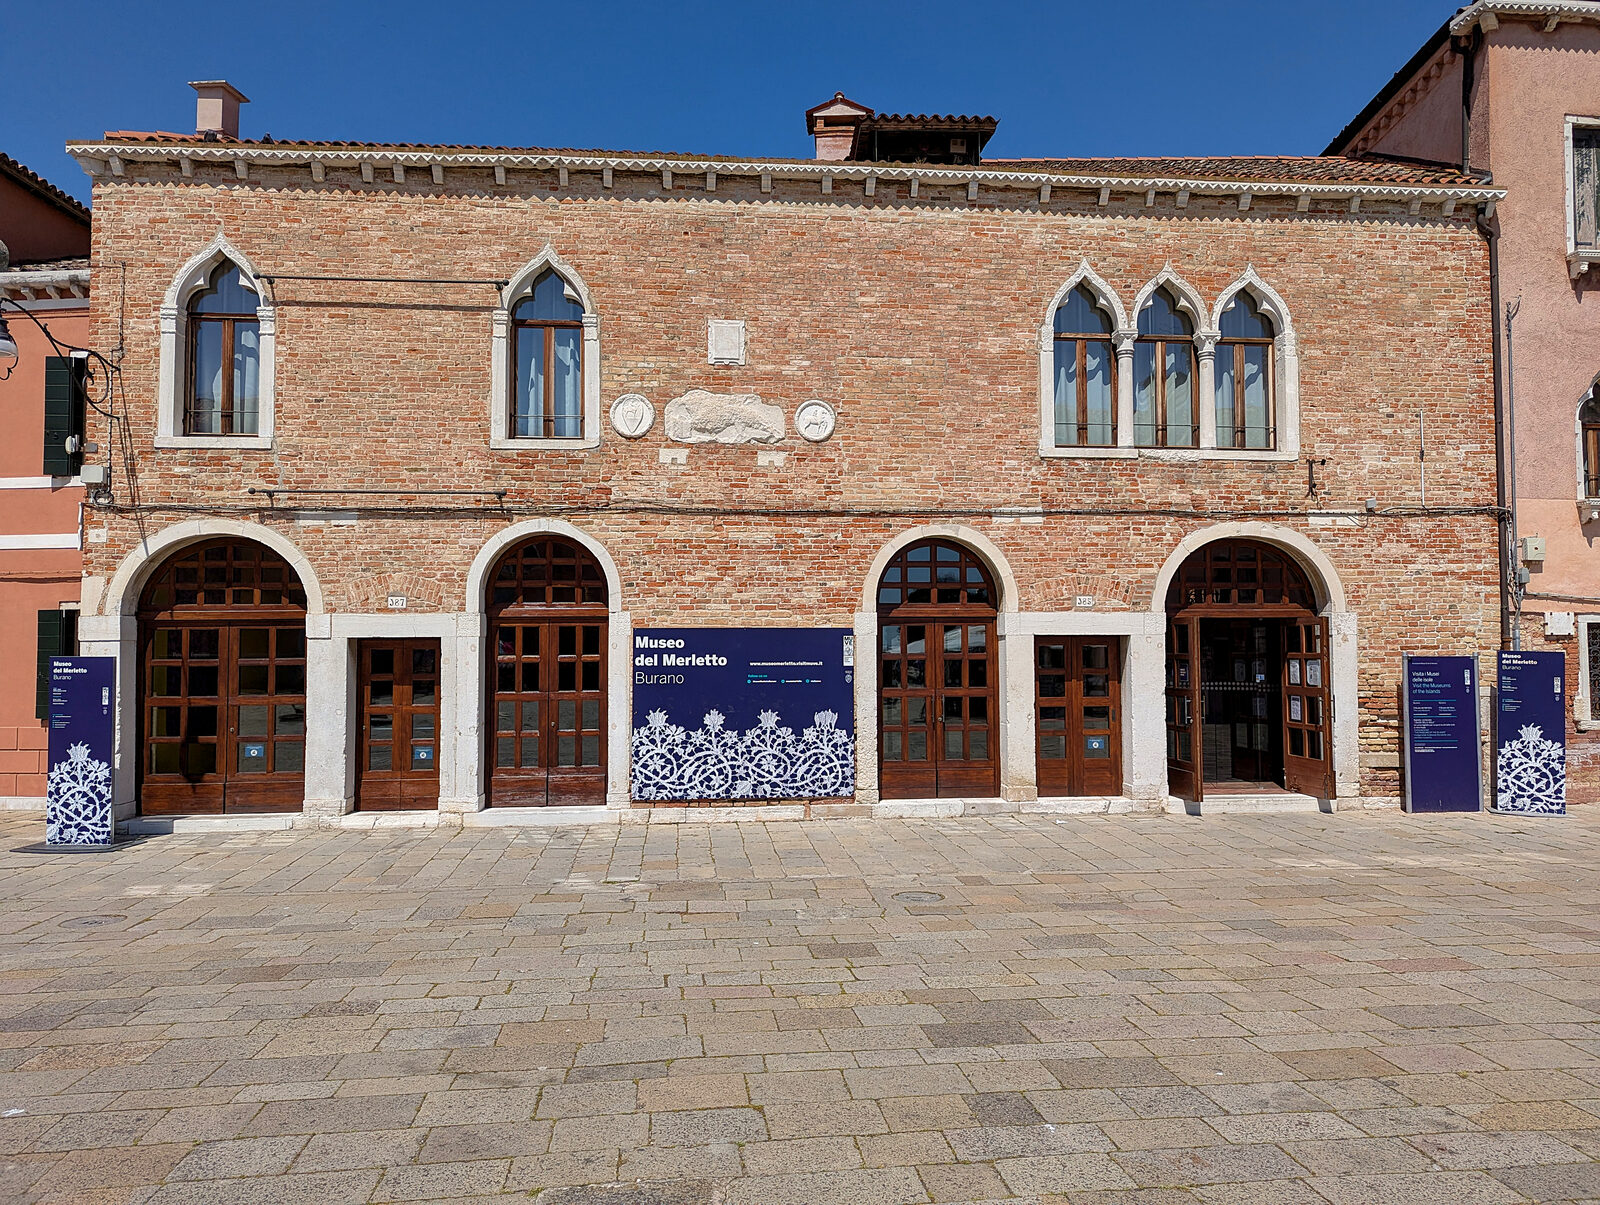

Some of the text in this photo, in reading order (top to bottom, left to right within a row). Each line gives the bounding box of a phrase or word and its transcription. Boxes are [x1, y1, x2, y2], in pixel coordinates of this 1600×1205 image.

[635, 636, 685, 649] Museo
[635, 654, 728, 667] del Merletto
[635, 672, 685, 684] Burano
